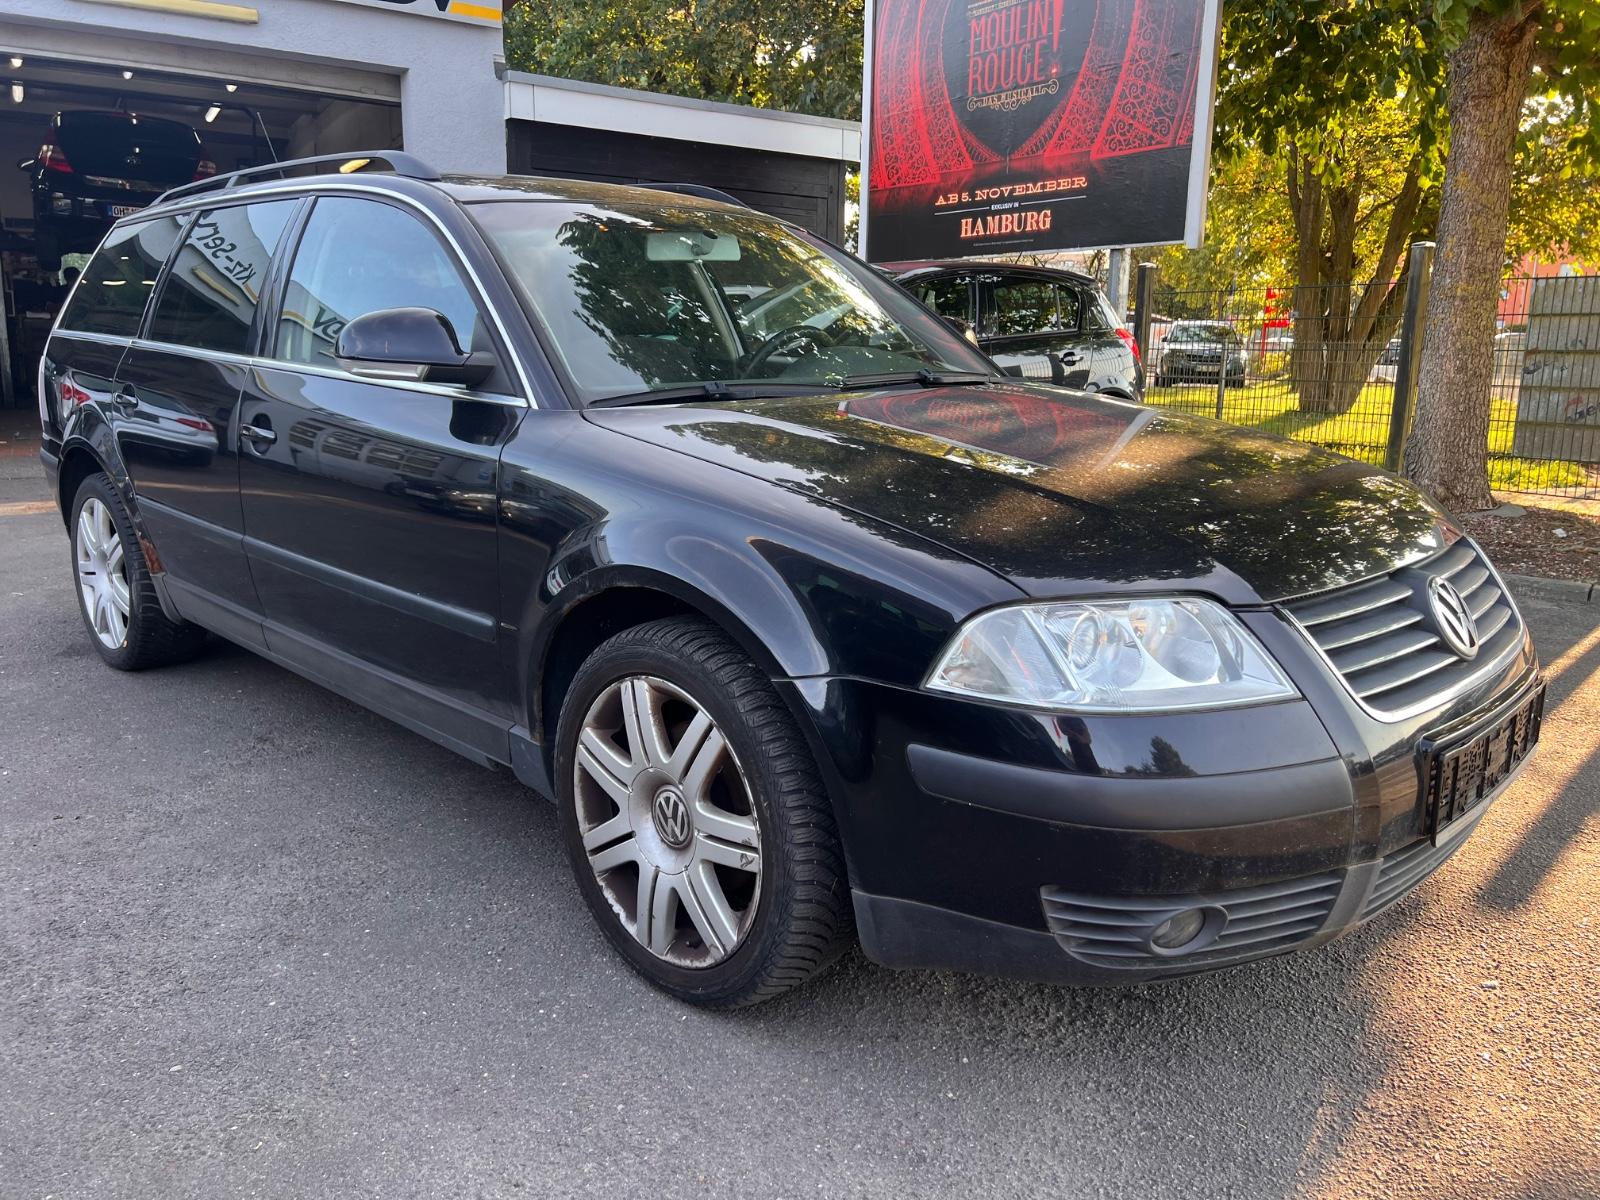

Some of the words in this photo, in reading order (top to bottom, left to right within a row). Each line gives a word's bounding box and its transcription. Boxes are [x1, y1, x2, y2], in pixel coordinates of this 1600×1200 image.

[934, 192, 959, 206] AB
[961, 192, 972, 202] 5.
[974, 176, 1088, 201] NOVEMBER
[960, 210, 1052, 238] HAMBURG
